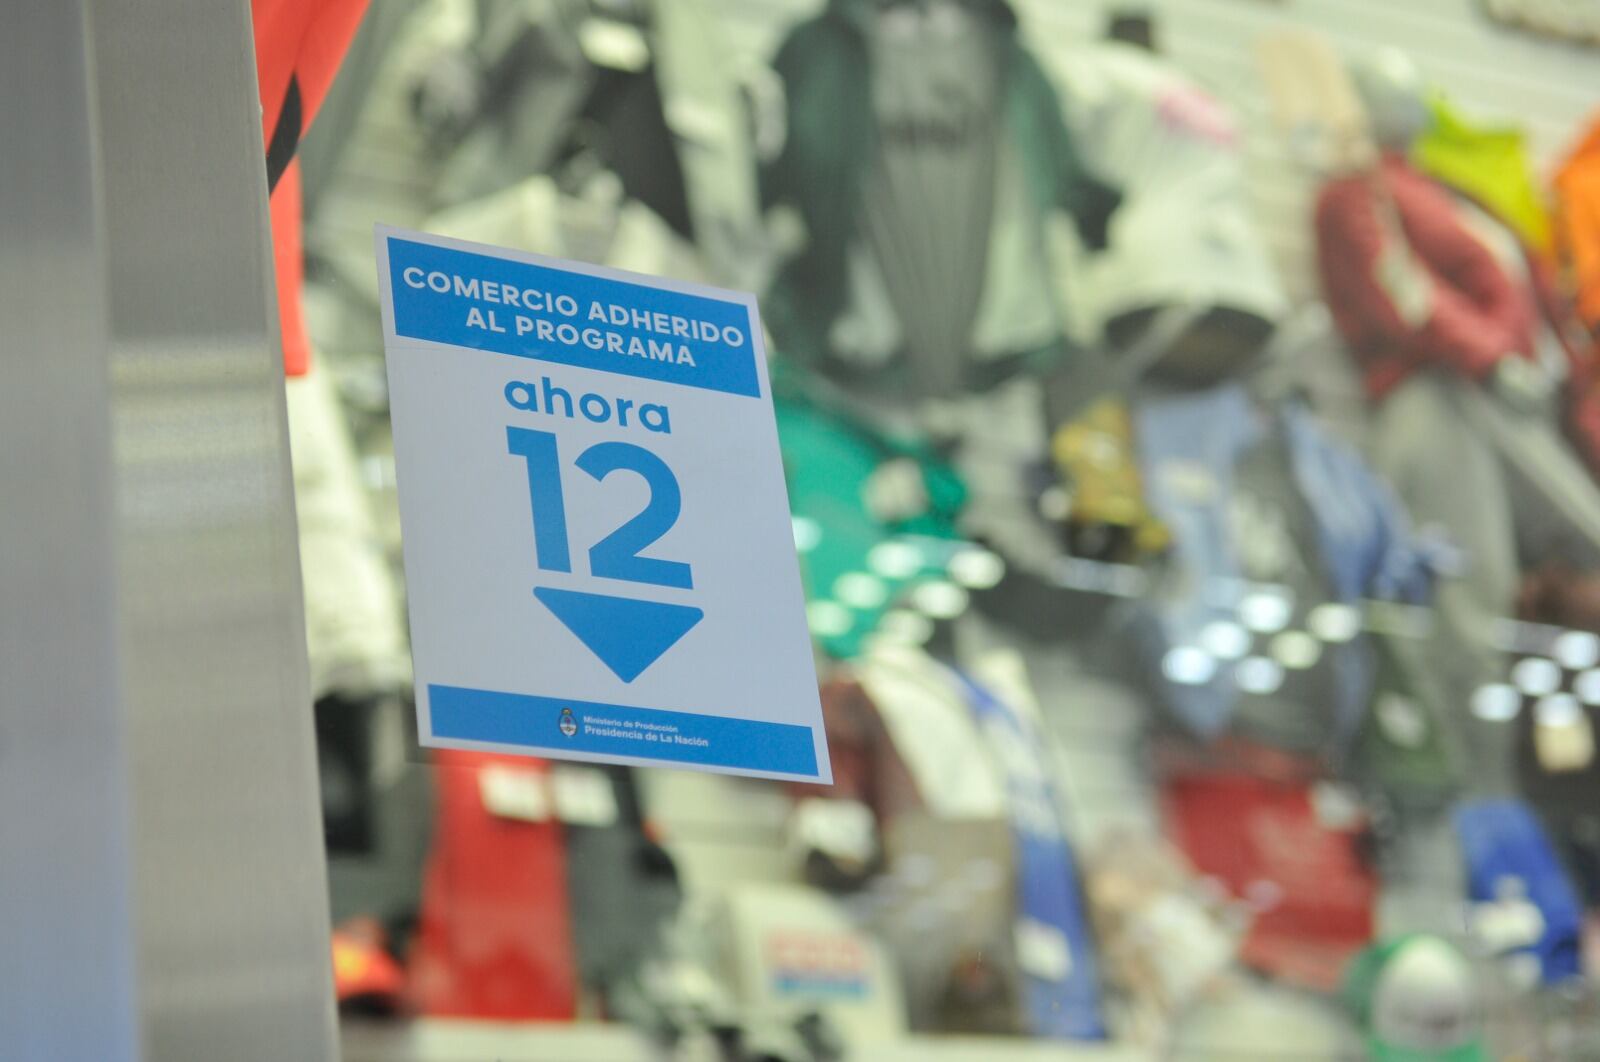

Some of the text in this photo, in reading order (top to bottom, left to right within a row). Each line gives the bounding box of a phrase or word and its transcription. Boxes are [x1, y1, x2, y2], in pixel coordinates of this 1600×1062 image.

[403, 266, 744, 347] COMERCIO ADHERIDO
[466, 308, 696, 367] AL PROGRAMA
[504, 376, 672, 434] ahora
[506, 425, 694, 590] 12
[583, 715, 679, 733] Ministerio de Producción
[584, 725, 709, 747] Presidencia de La Nación
